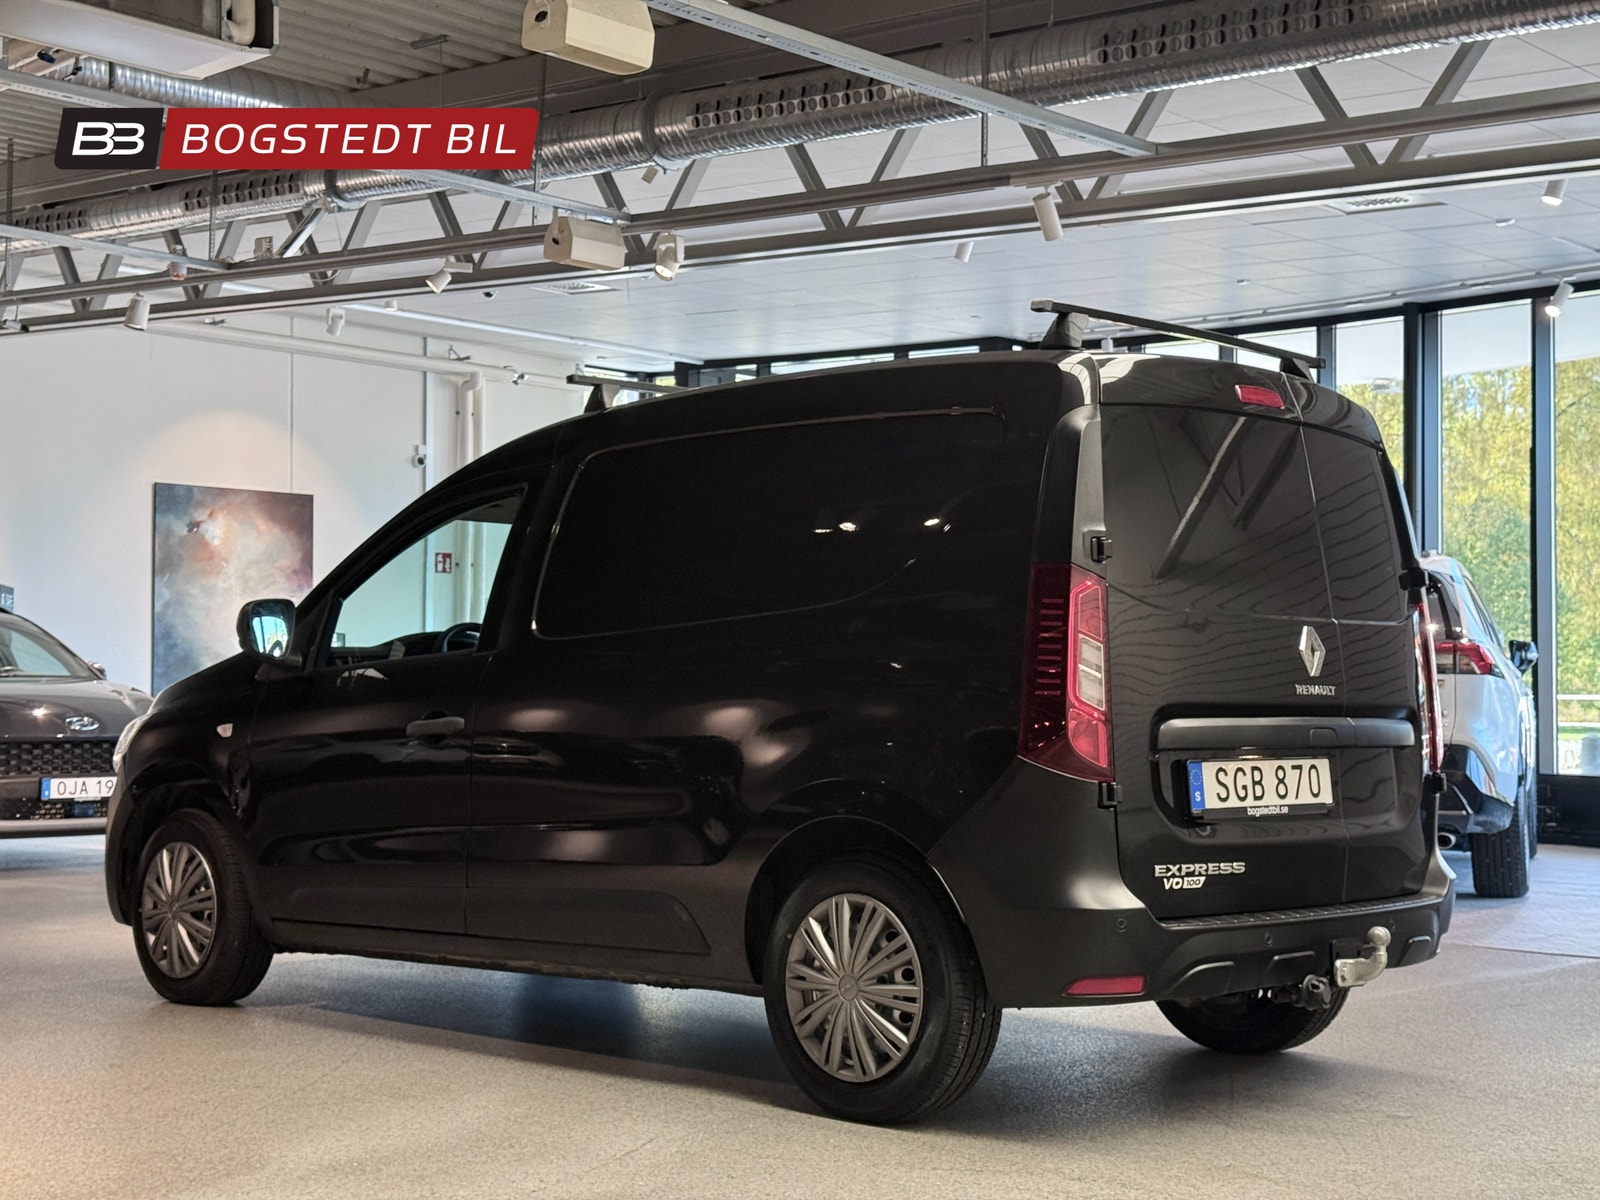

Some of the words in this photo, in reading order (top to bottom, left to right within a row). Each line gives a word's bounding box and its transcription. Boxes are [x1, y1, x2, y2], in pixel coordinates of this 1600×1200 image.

[1295, 684, 1336, 696] RENAULT
[57, 780, 88, 796] OJA
[96, 779, 115, 795] 19
[1215, 765, 1265, 803] SGB
[1274, 763, 1321, 800] 870
[1194, 790, 1202, 802] S
[1154, 862, 1246, 877] EXPRESS
